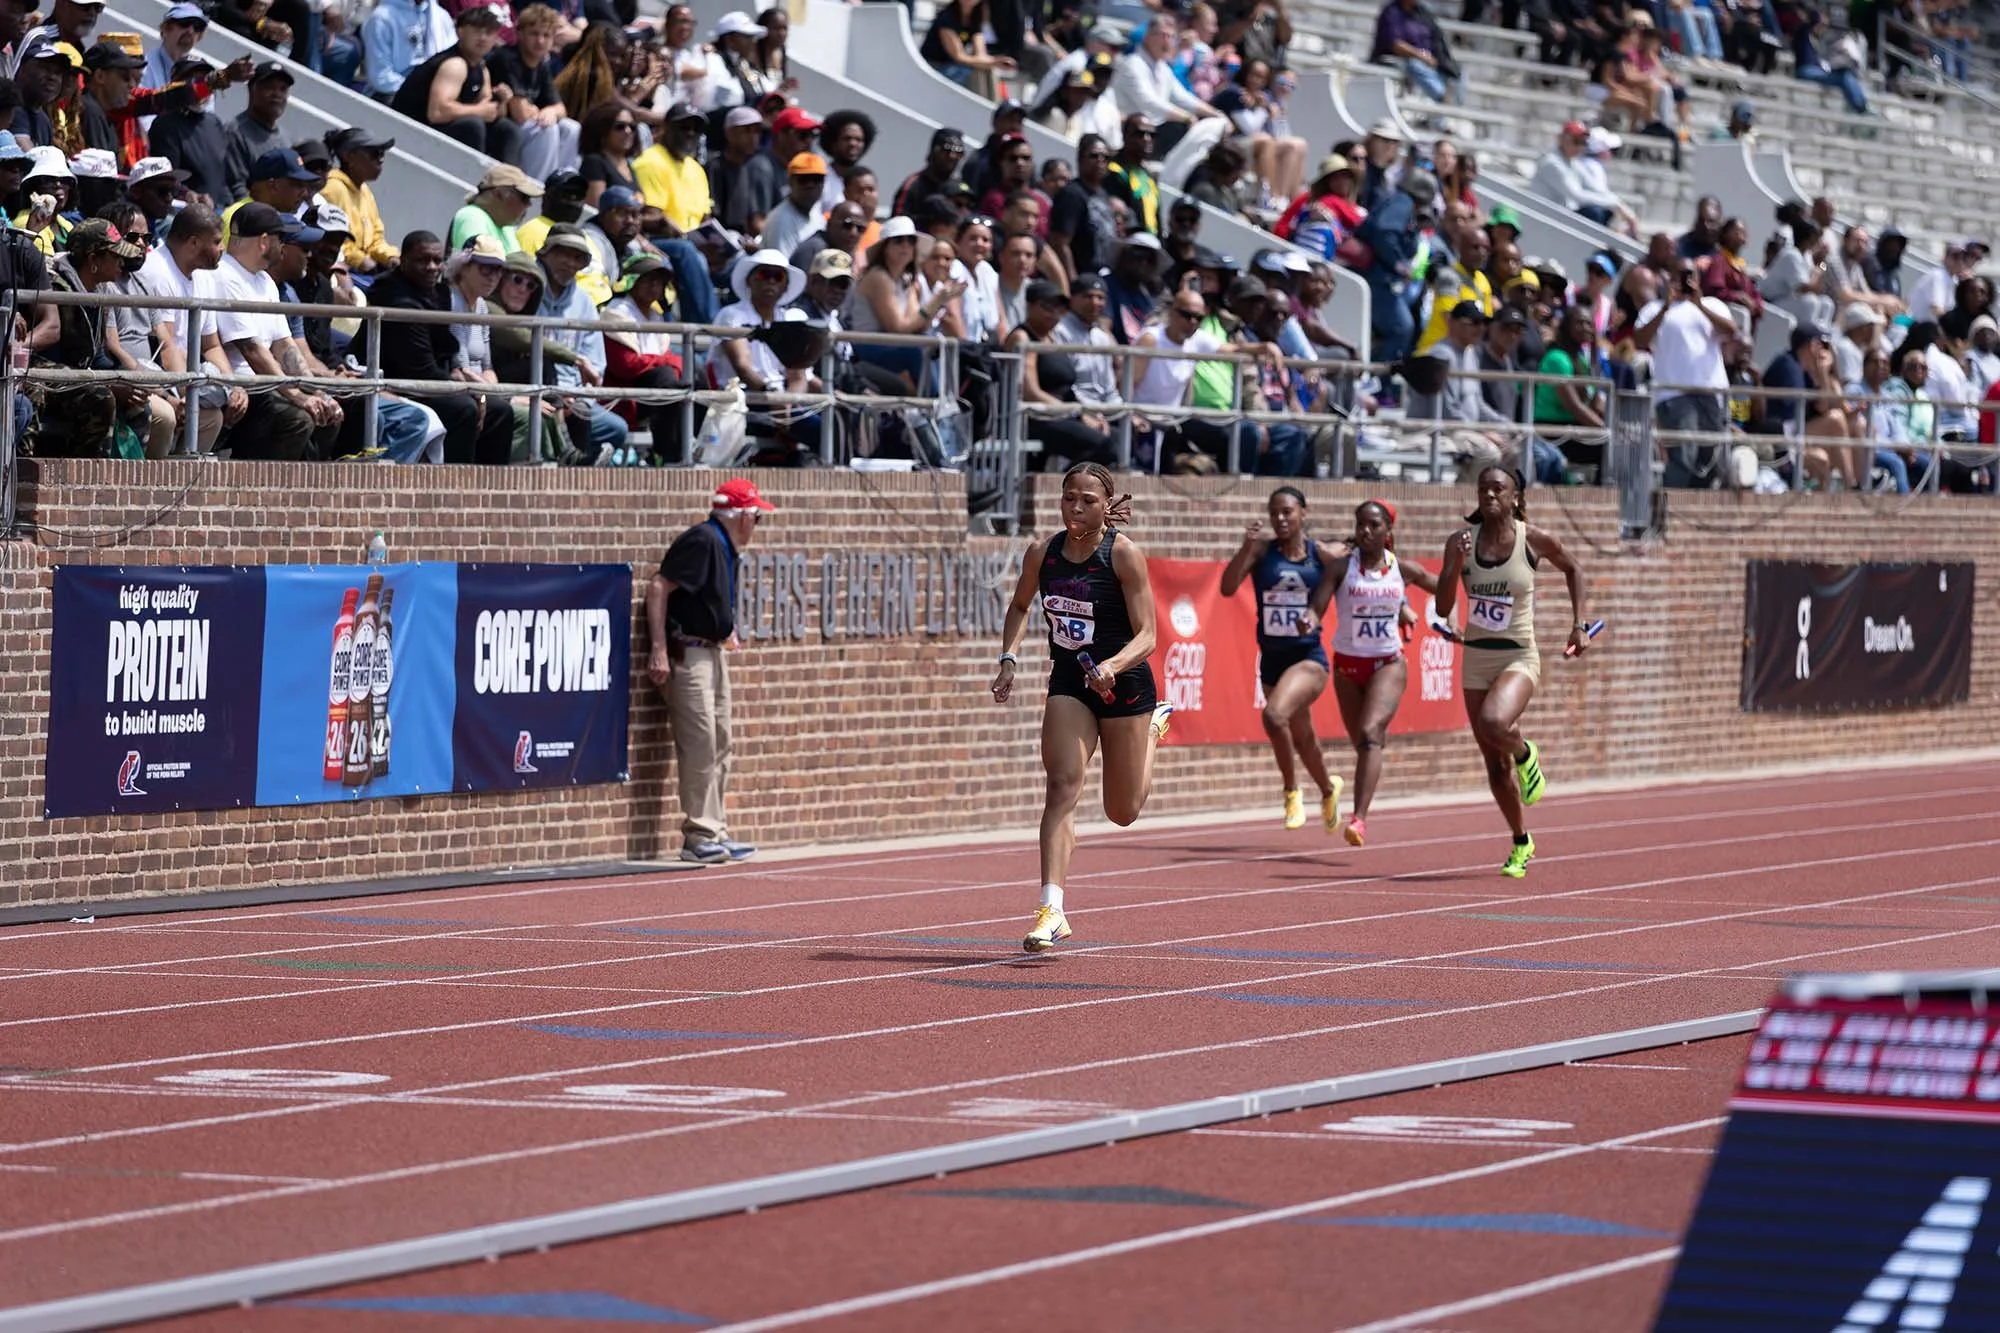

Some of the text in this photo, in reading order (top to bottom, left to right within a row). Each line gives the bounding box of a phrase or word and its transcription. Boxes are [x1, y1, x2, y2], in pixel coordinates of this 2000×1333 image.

[1348, 586, 1399, 599] MARYLAND
[1471, 581, 1508, 594] SOUTH
[119, 584, 200, 615] high quality
[1063, 600, 1081, 608] PENN
[1063, 606, 1088, 615] RELAYS
[1269, 610, 1300, 626] AR
[1473, 600, 1505, 622] AG
[1055, 617, 1086, 642] AB
[1357, 621, 1390, 638] AK
[107, 619, 210, 702] PROTEIN
[354, 642, 372, 667] CORE
[1164, 641, 1206, 678] GOOD
[353, 669, 370, 687] POWER
[105, 707, 206, 736] to build muscle
[349, 720, 367, 763] 26
